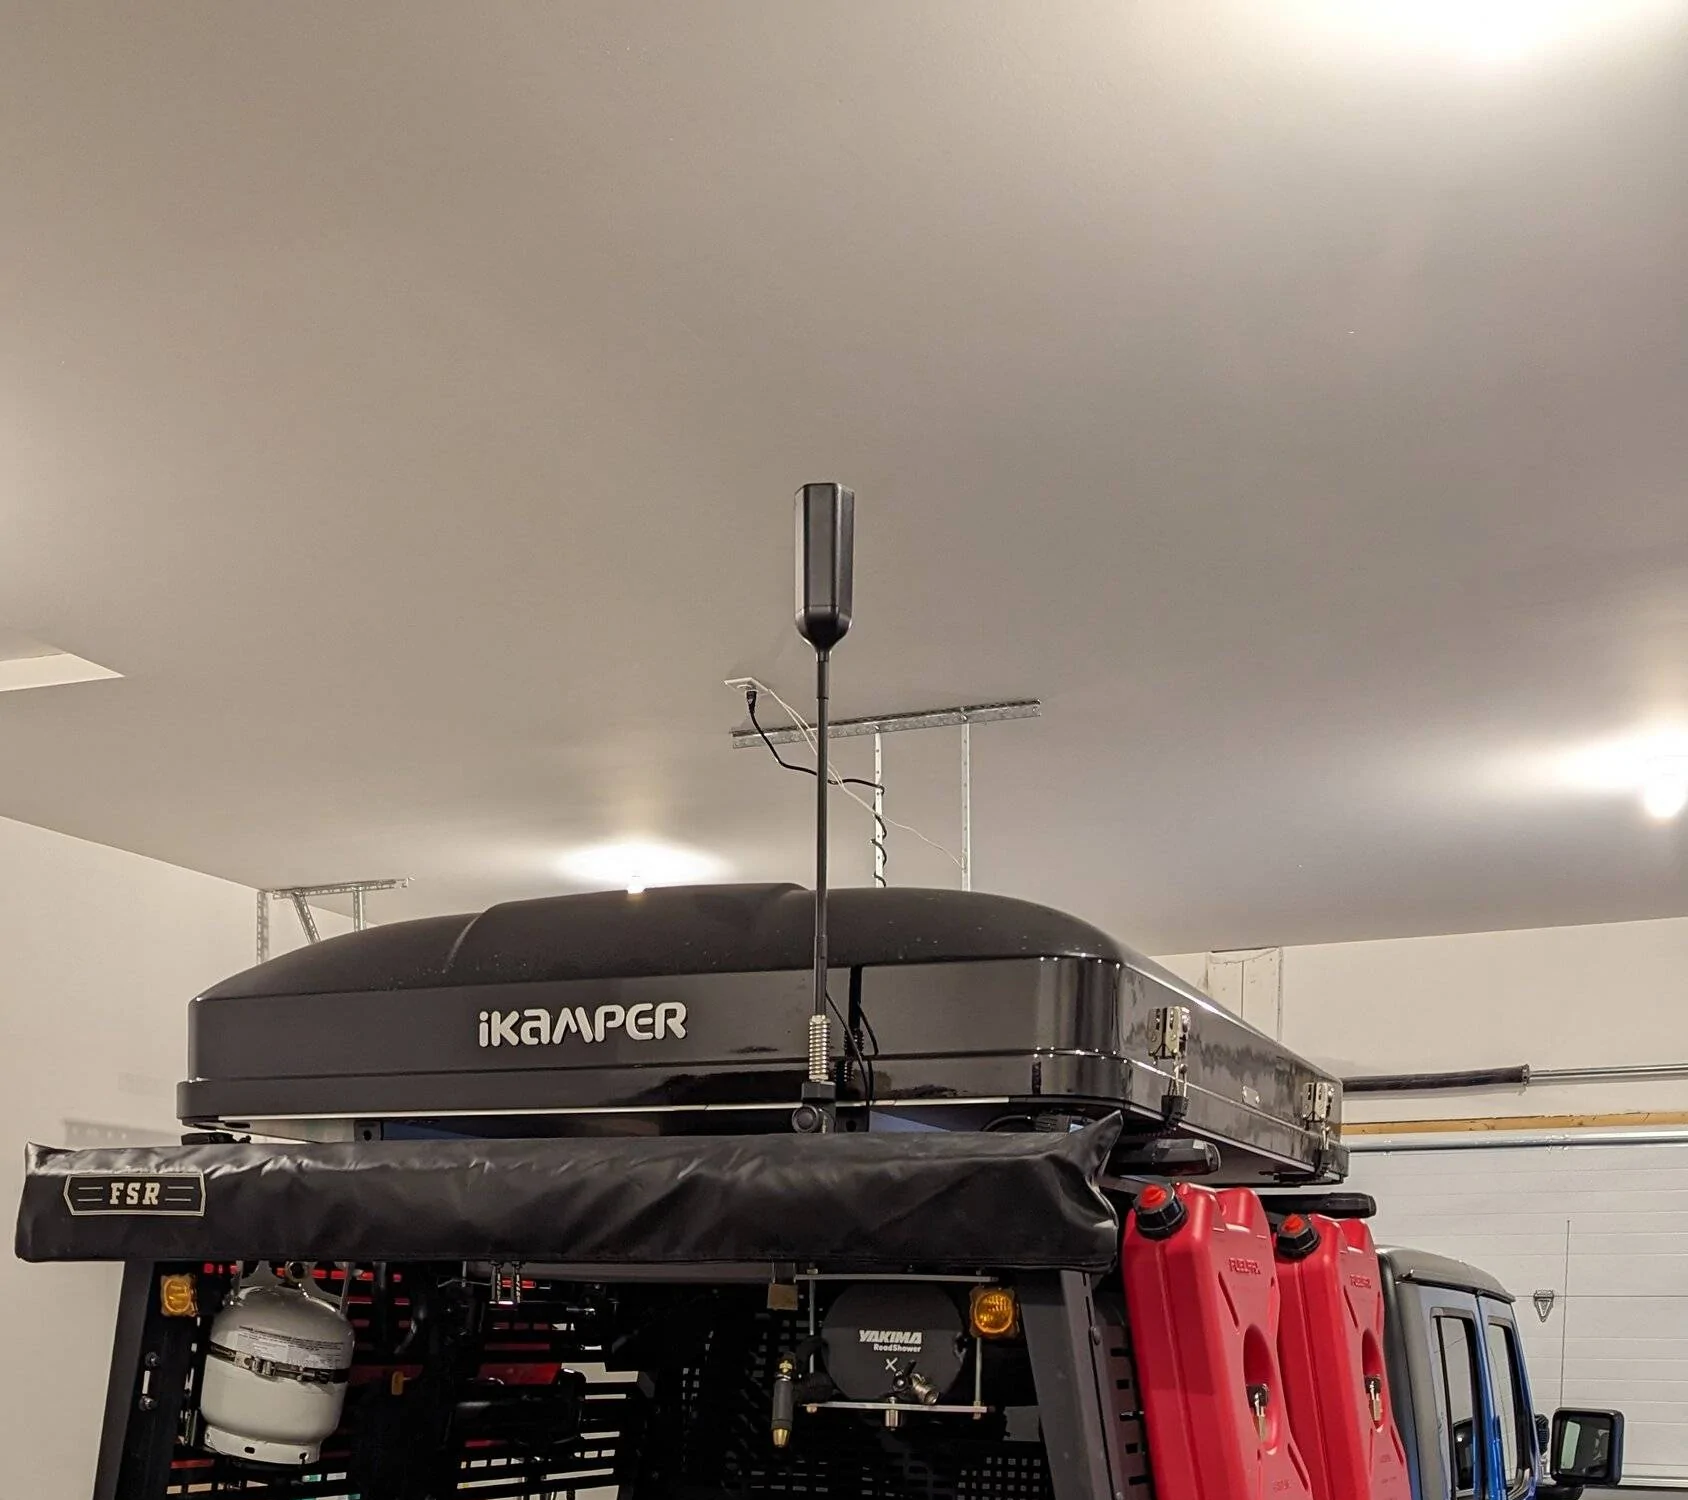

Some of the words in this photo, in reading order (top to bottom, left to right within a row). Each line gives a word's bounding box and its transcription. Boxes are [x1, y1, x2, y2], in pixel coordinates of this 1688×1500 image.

[109, 1182, 160, 1205] FSR
[859, 1330, 922, 1344] YAKIMA
[873, 1343, 921, 1352] RoadShower
